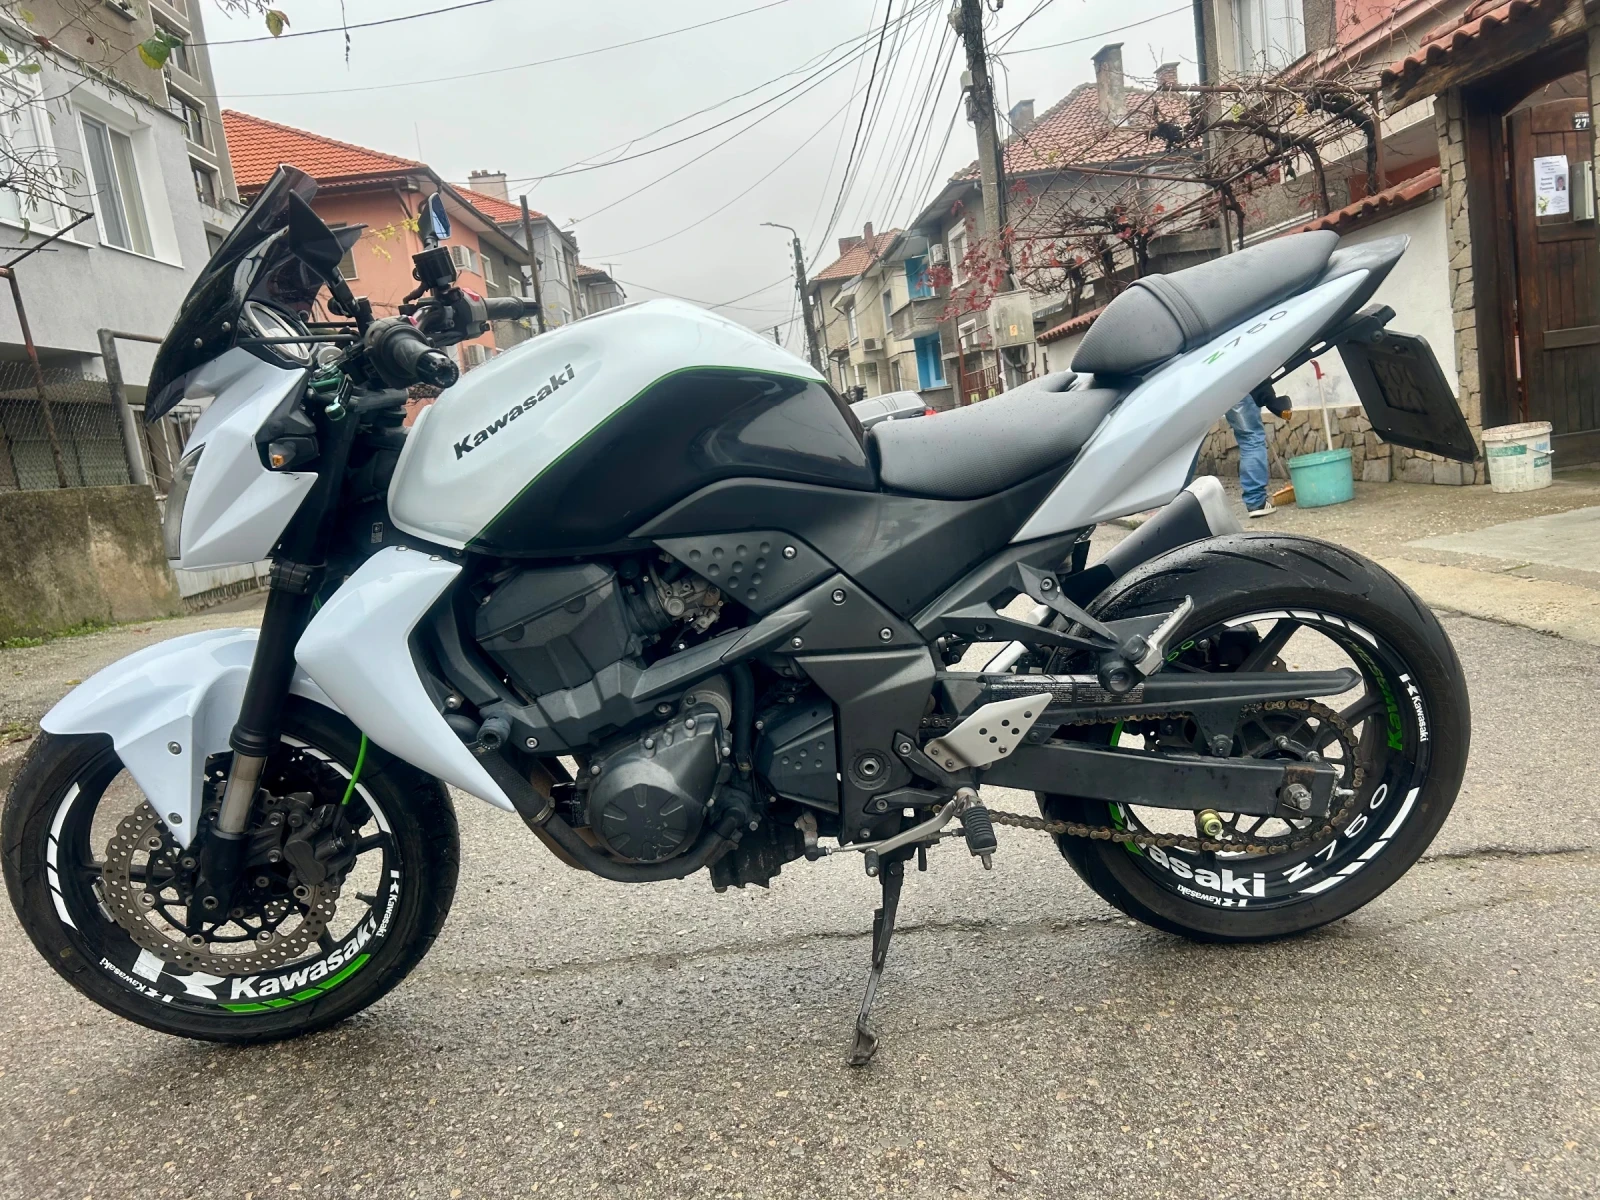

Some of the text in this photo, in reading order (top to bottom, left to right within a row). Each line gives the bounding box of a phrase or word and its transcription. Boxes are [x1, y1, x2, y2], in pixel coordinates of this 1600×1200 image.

[453, 363, 575, 461] Kawasaki
[1411, 695, 1429, 742] Kawasaki
[375, 894, 399, 938] Kawasaki
[1177, 884, 1222, 906] Kawasaki
[99, 957, 147, 993] Kawasaki
[230, 911, 377, 1000] Kawasaki
